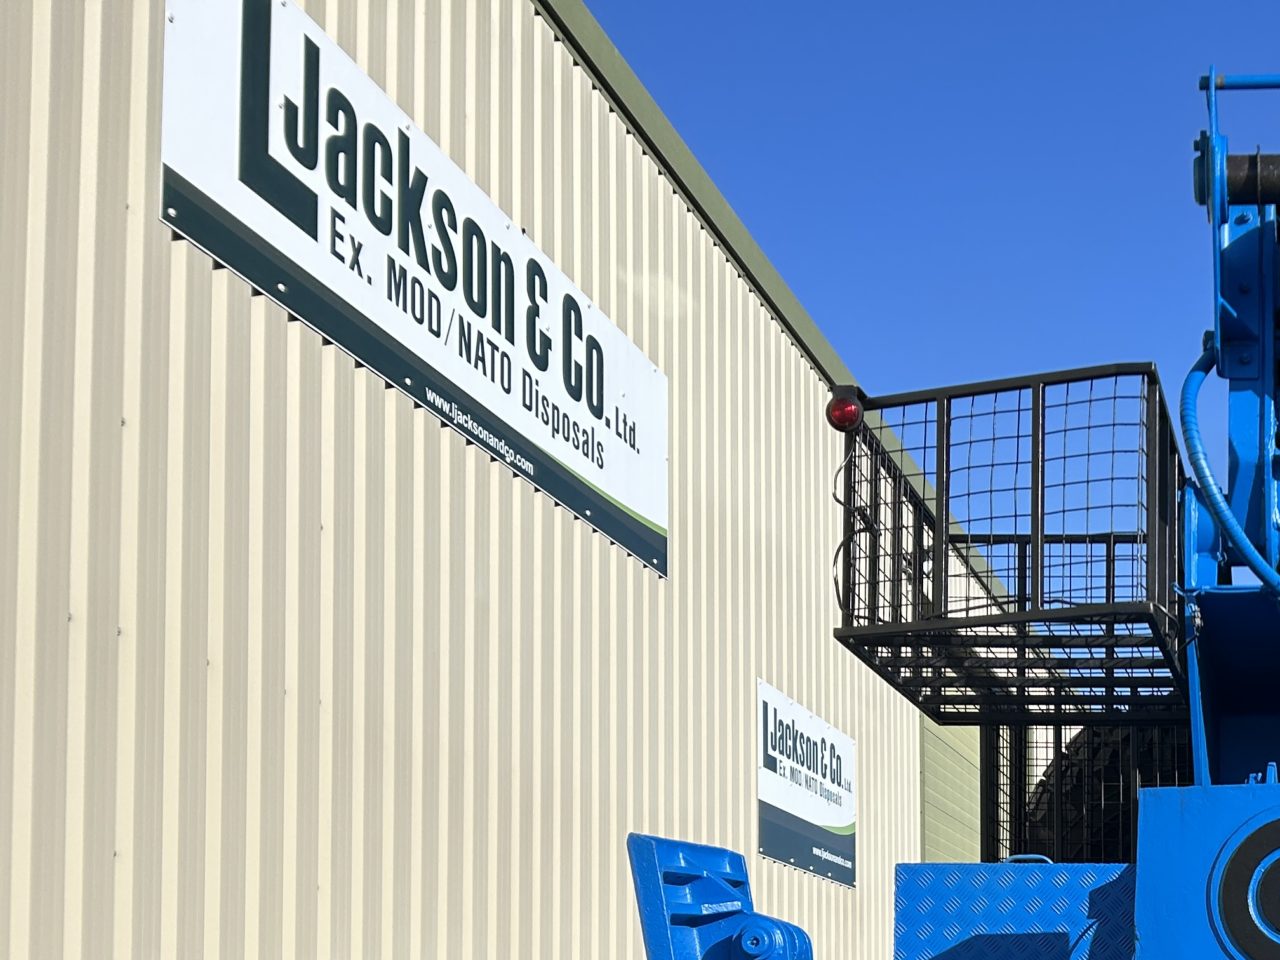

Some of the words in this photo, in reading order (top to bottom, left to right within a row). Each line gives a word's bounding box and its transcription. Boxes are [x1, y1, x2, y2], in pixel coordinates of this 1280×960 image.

[330, 206, 372, 286] Ex.
[522, 368, 604, 469] Disposals
[526, 258, 552, 372] &
[562, 293, 611, 429] Co.
[615, 406, 640, 454] Ltd.
[425, 387, 534, 476] www.ljacksonandco.com
[779, 760, 788, 779] Ex.
[821, 737, 828, 780] &
[830, 743, 844, 788] Co.
